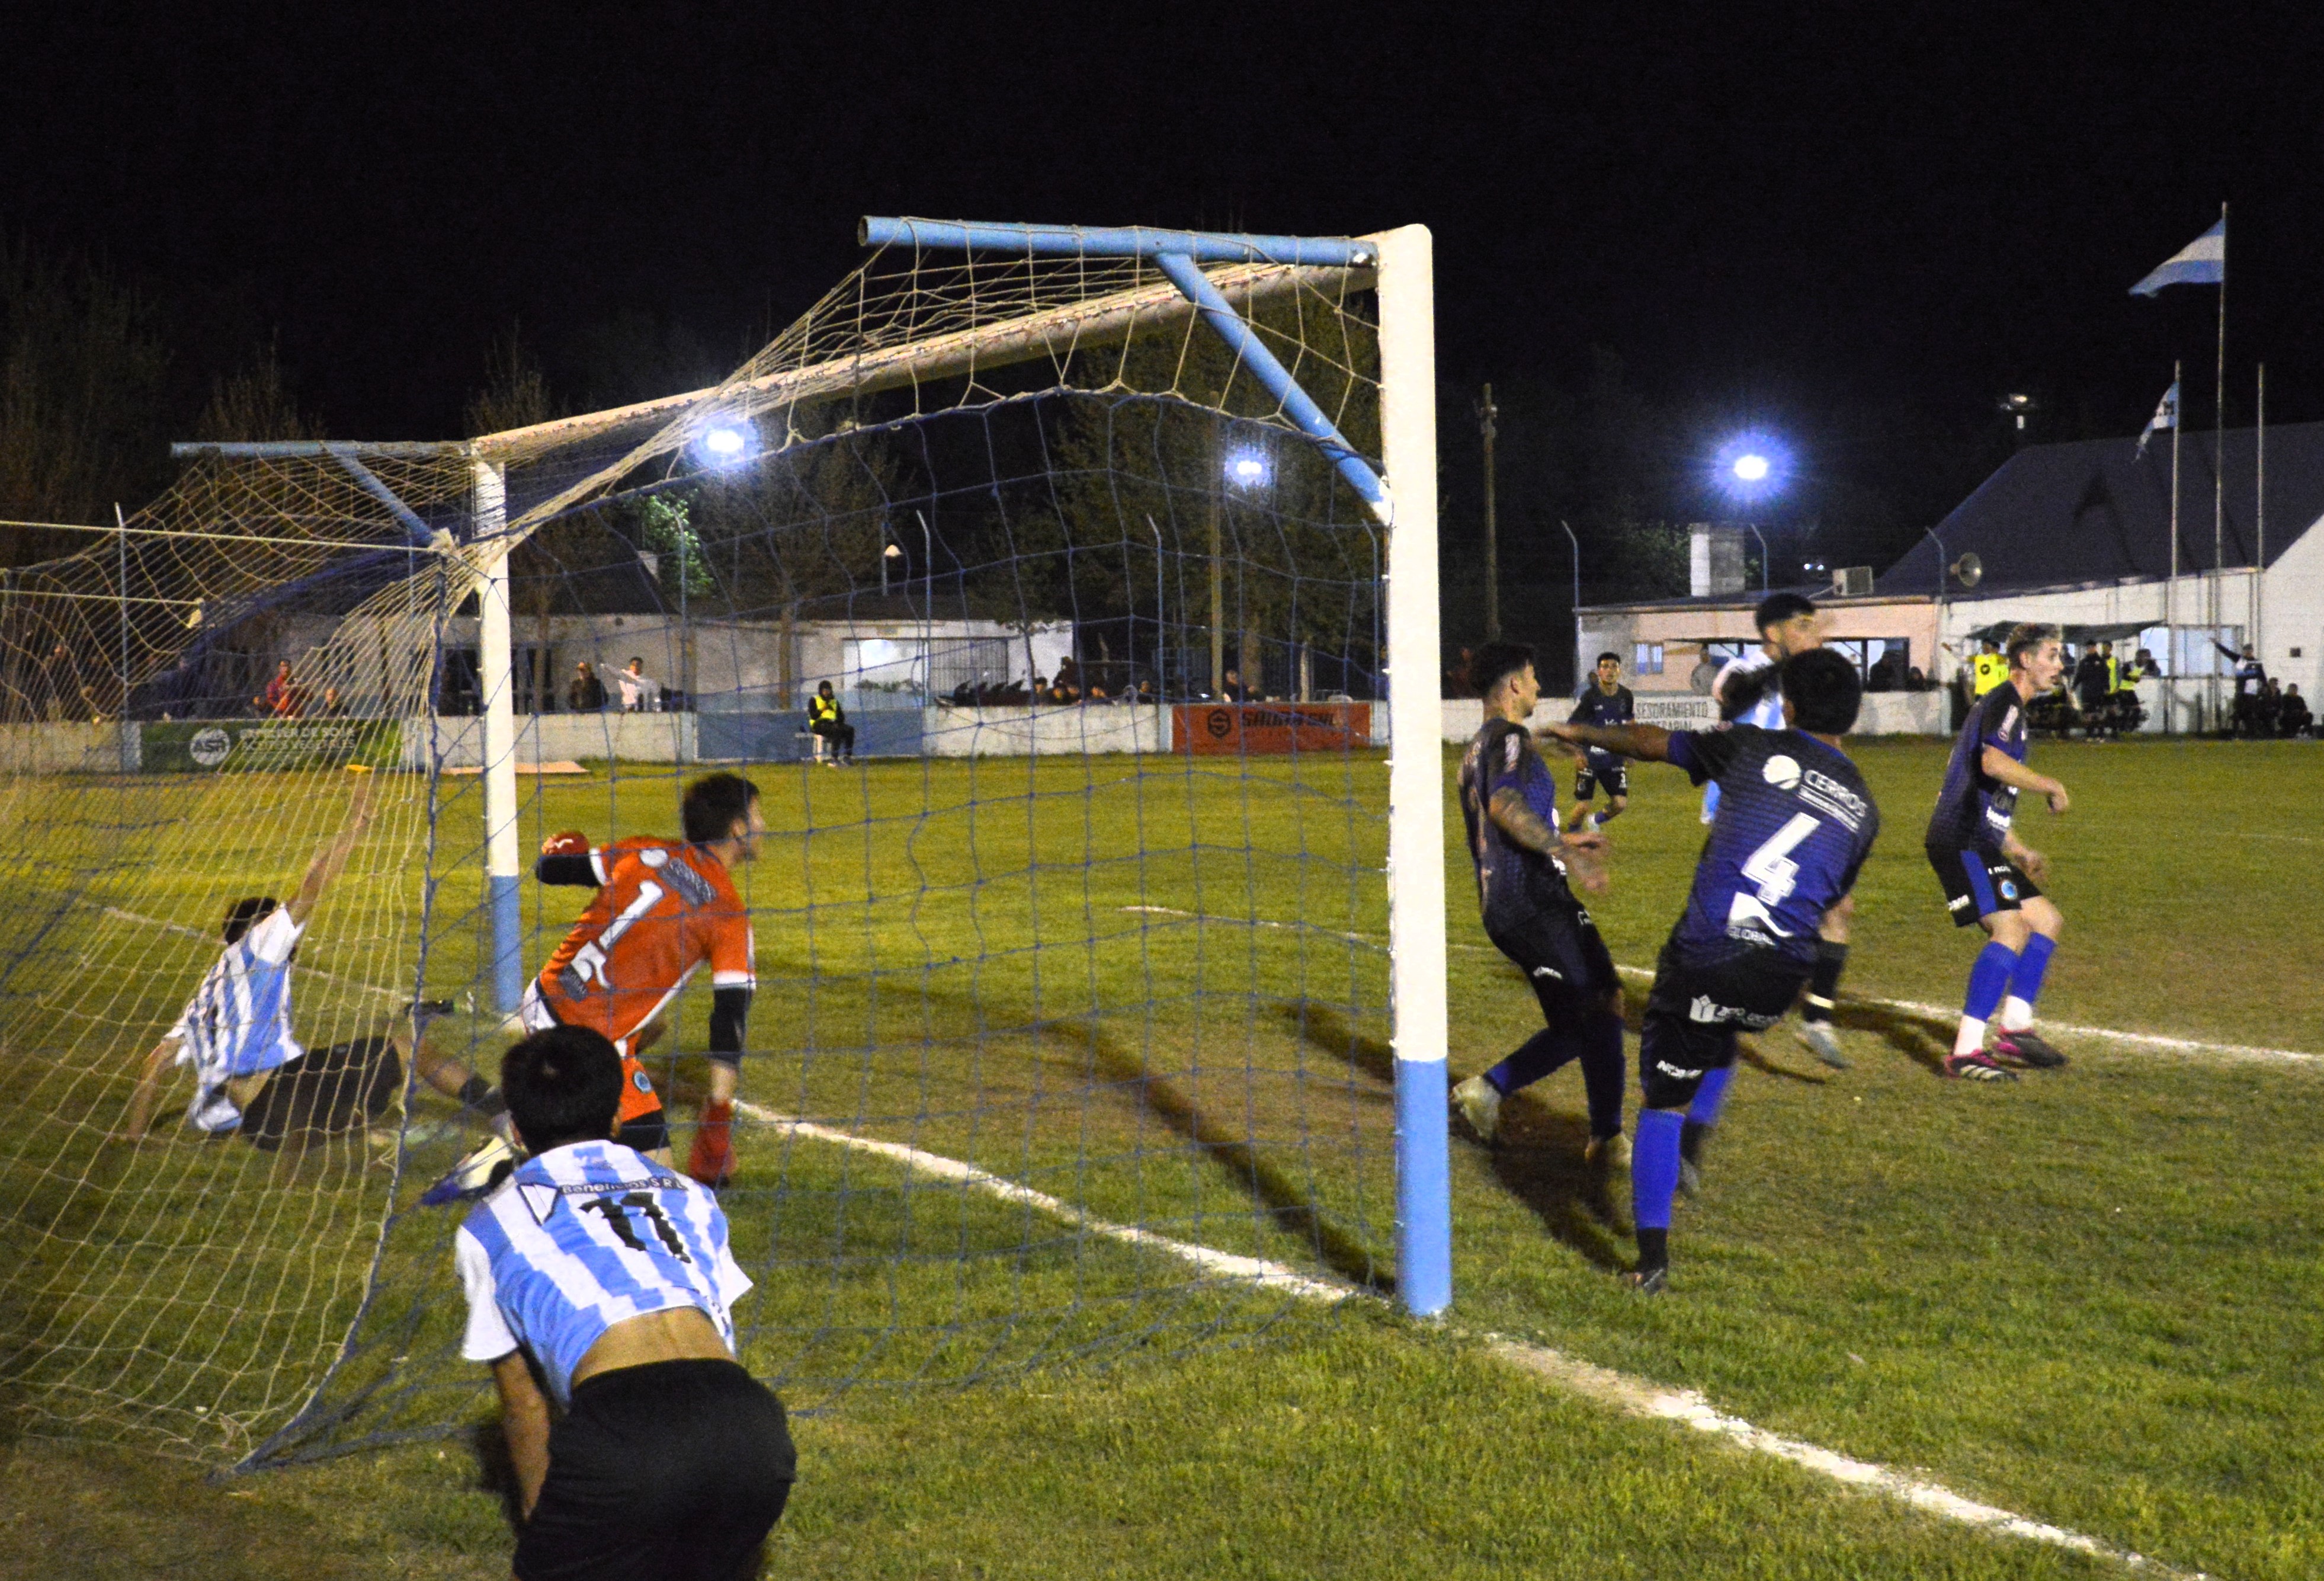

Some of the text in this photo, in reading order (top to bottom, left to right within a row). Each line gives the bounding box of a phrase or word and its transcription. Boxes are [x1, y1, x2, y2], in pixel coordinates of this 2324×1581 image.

[1634, 701, 1708, 718] SESORAMIENTO
[1804, 769, 1867, 818] CERROS
[1740, 811, 1822, 907] 4
[598, 879, 665, 950] 1
